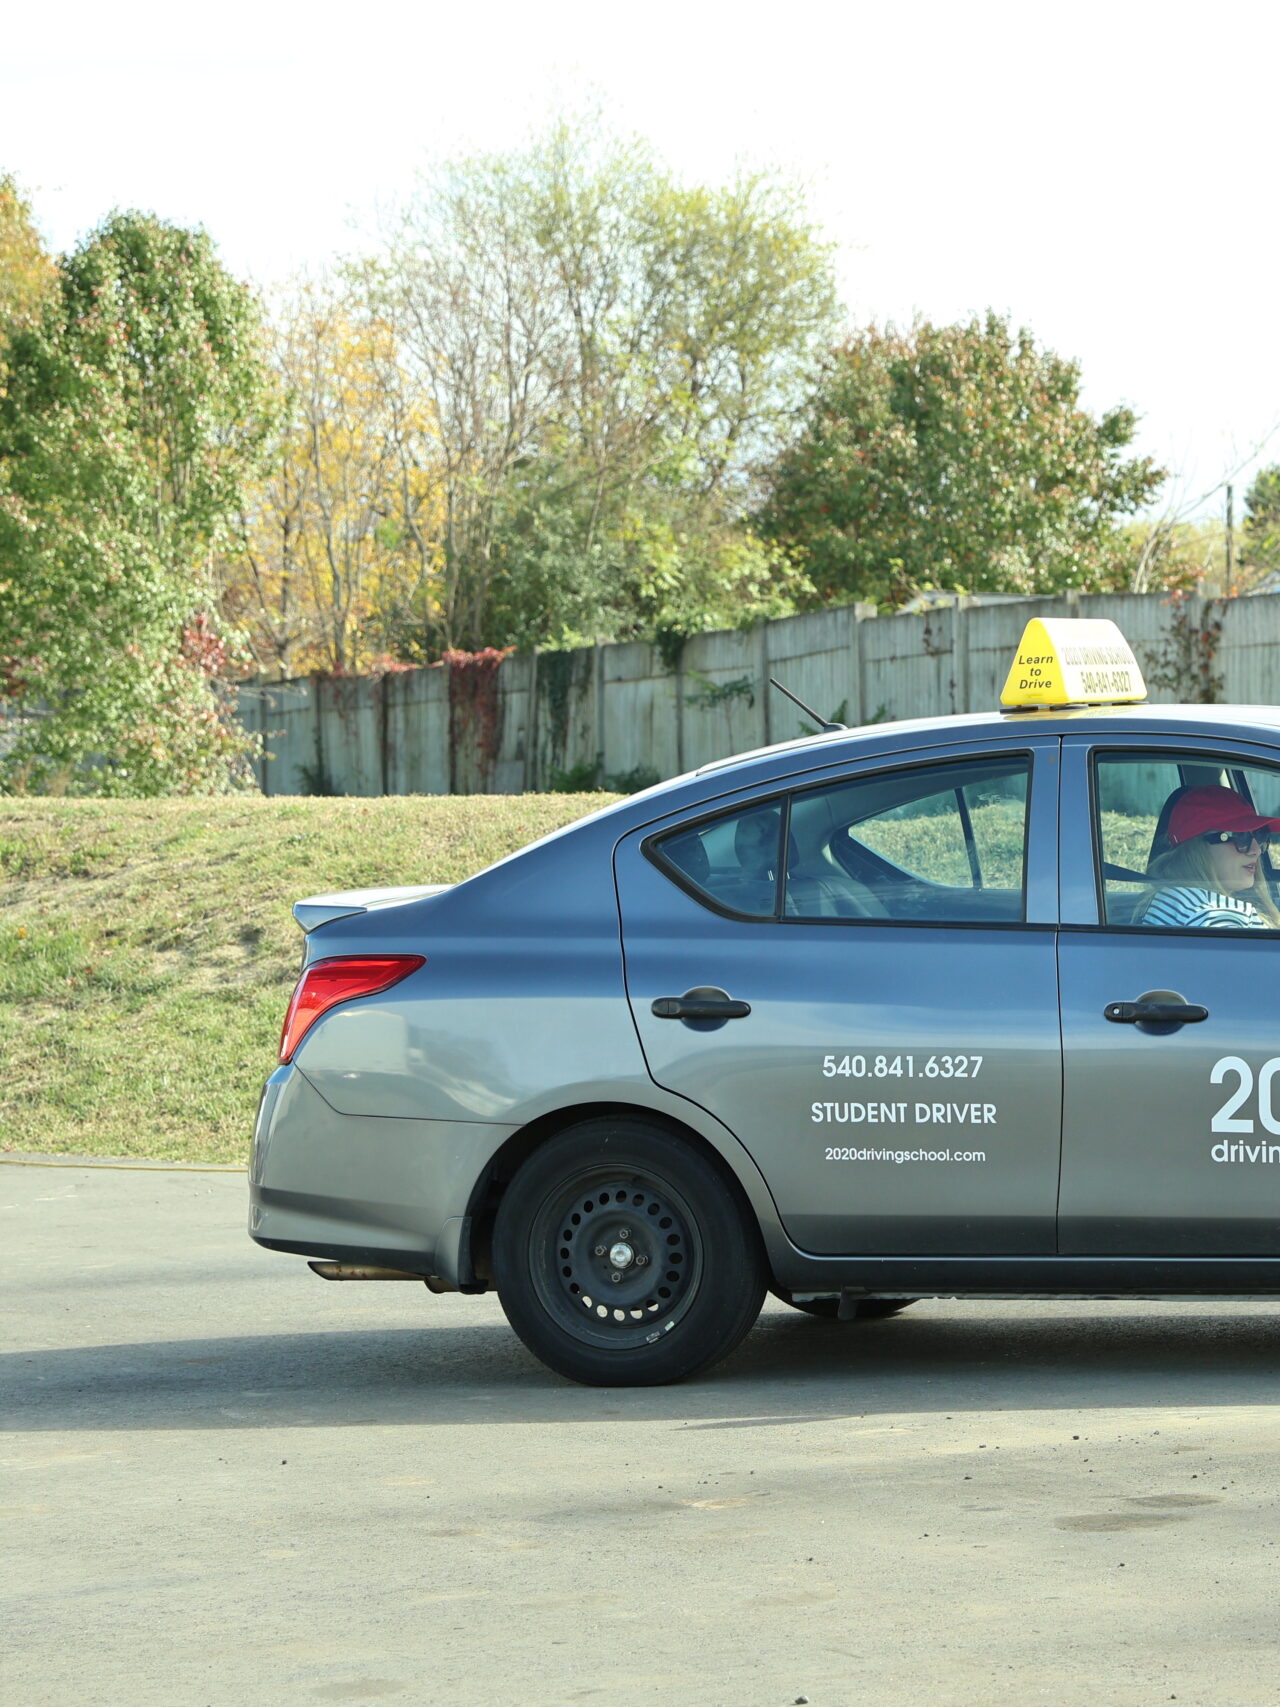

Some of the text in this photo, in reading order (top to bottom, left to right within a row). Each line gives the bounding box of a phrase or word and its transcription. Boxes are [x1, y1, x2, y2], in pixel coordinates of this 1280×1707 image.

[1018, 655, 1054, 665] Learn
[1030, 667, 1042, 677] to
[1019, 679, 1052, 689] Drive
[1080, 671, 1132, 694] 540-841-6327
[822, 1055, 983, 1078] 540.841.6327
[811, 1102, 997, 1124] STUDENT DRIVER
[825, 1147, 986, 1164] 2020drivingschool.com
